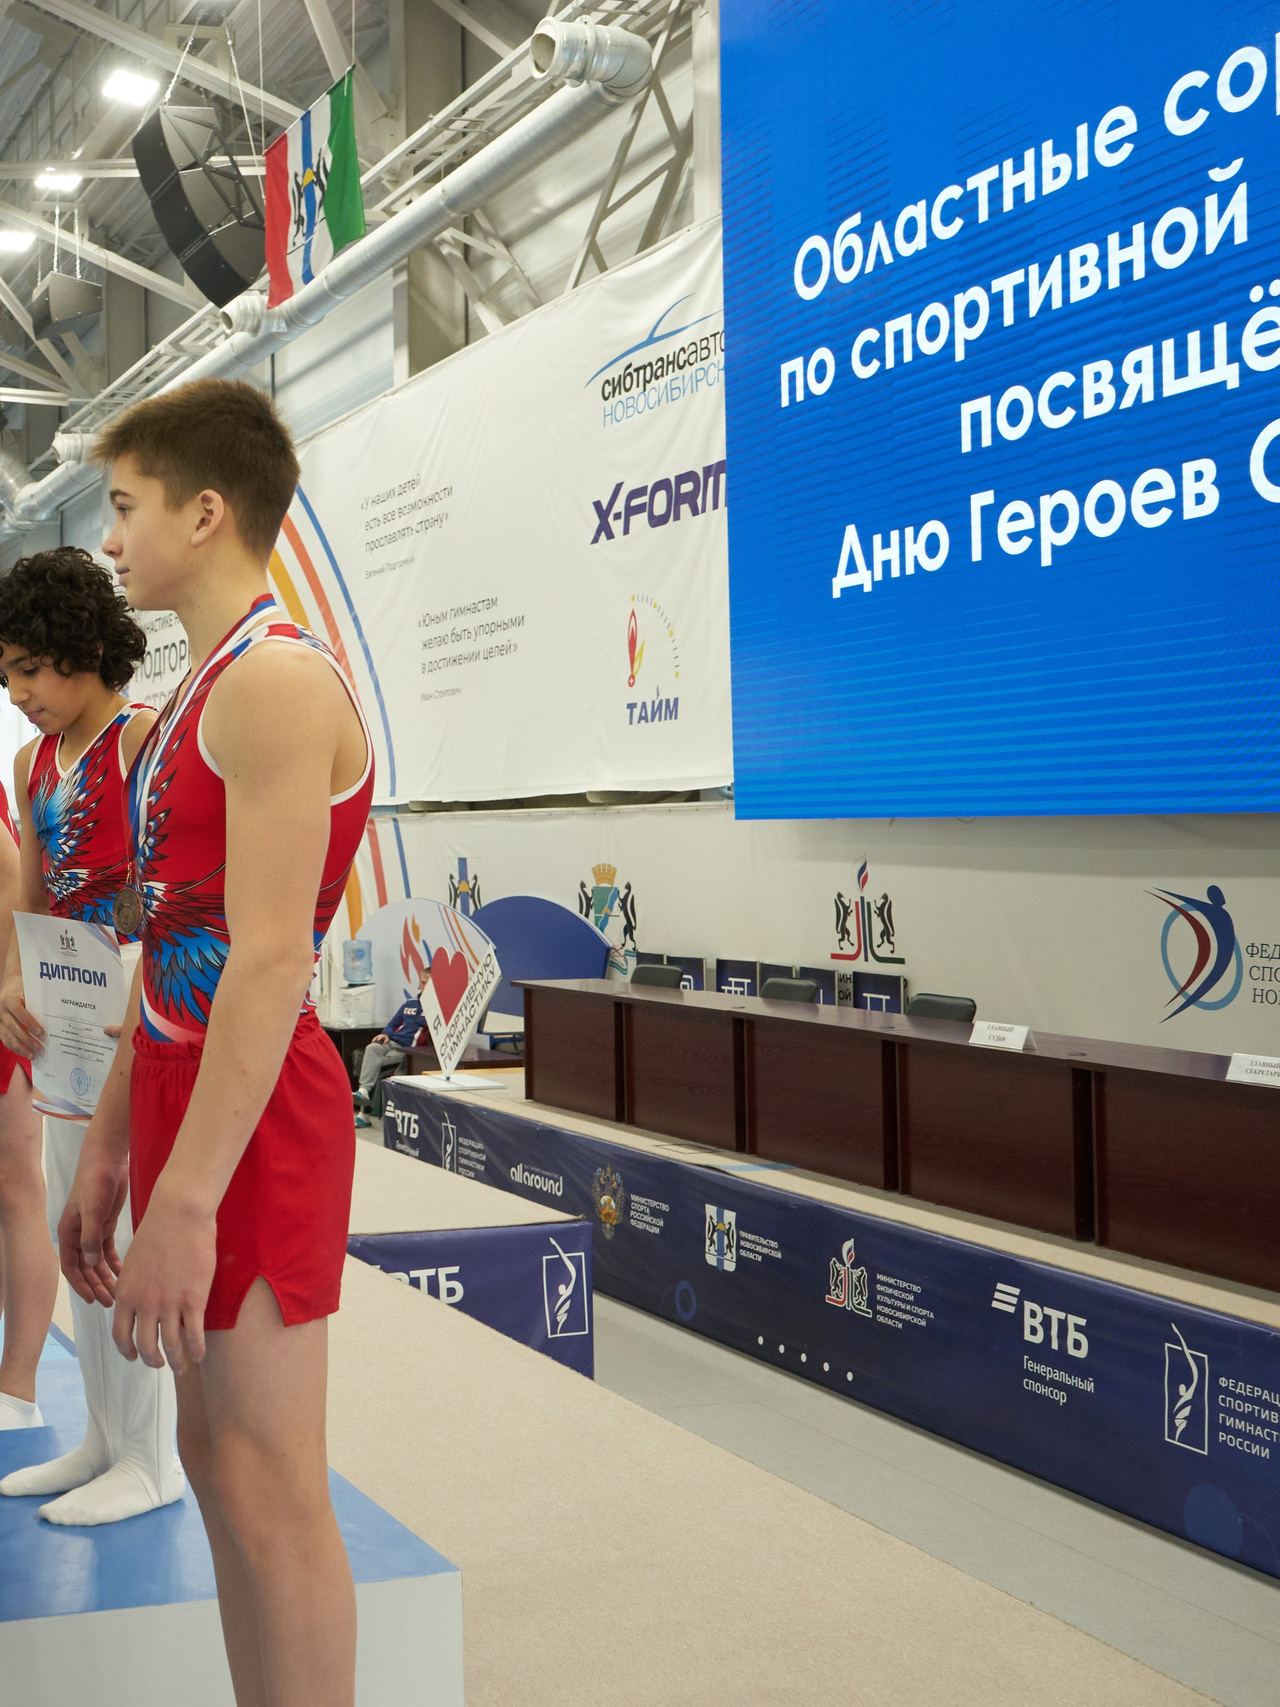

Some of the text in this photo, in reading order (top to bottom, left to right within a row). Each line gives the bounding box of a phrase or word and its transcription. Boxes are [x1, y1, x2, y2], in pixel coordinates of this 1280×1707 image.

[793, 32, 1280, 301] Областные со
[780, 157, 1249, 408] по спортивной
[961, 277, 1280, 454] посвящё
[371, 488, 396, 507] наших
[398, 473, 421, 498] детей
[365, 485, 453, 531] есть все возможности
[365, 512, 449, 554] прославлять страну»
[832, 518, 950, 599] Дню
[970, 457, 1220, 567] Героев
[450, 596, 498, 620] гимнастам
[421, 615, 525, 651] желаю быть упорными
[135, 639, 191, 683] ОДГОР
[422, 639, 518, 674] в достижении целей»
[626, 685, 679, 725] ТАЙМ
[39, 961, 108, 988] ДИПЛОМ
[440, 953, 492, 1057] СПОРТИВНУЮ
[1252, 988, 1280, 1005] НО
[432, 1014, 442, 1036] Я
[442, 964, 495, 1070] ГИМНАСТИКУ
[395, 1109, 419, 1139] ВТБ
[630, 1194, 670, 1212] МИНИСТЕРСТВО
[630, 1202, 650, 1215] СПОРТА
[630, 1210, 664, 1228] РОССИЙСКОЙ
[630, 1219, 660, 1235] ФЕДЕРАЦИИ
[739, 1230, 778, 1249] ПРАВИТЕЛЬСТВО
[739, 1240, 782, 1259] НОВОСИБИРСКОЙ
[739, 1249, 762, 1262] ОБЛАСТИ
[876, 1273, 922, 1293] МИНИСТЕРСТВО
[876, 1284, 915, 1302] ФИЗИЧЕСКОЙ
[876, 1294, 906, 1310] КУЛЬТУРЫ
[911, 1305, 935, 1319] СПОРТА
[876, 1304, 927, 1327] НОВОСИБИРСКОЙ
[876, 1315, 903, 1329] ОБЛАСТИ
[1023, 1299, 1089, 1359] ВТБ
[1023, 1354, 1095, 1393] Генеральный
[1023, 1378, 1067, 1406] спонсор
[1218, 1376, 1280, 1408] ФЕДЕРАЦ
[1218, 1394, 1279, 1424] СПОРТИВ
[1219, 1413, 1280, 1443] ГИМНАСТ
[1219, 1431, 1270, 1459] РОССИИ
